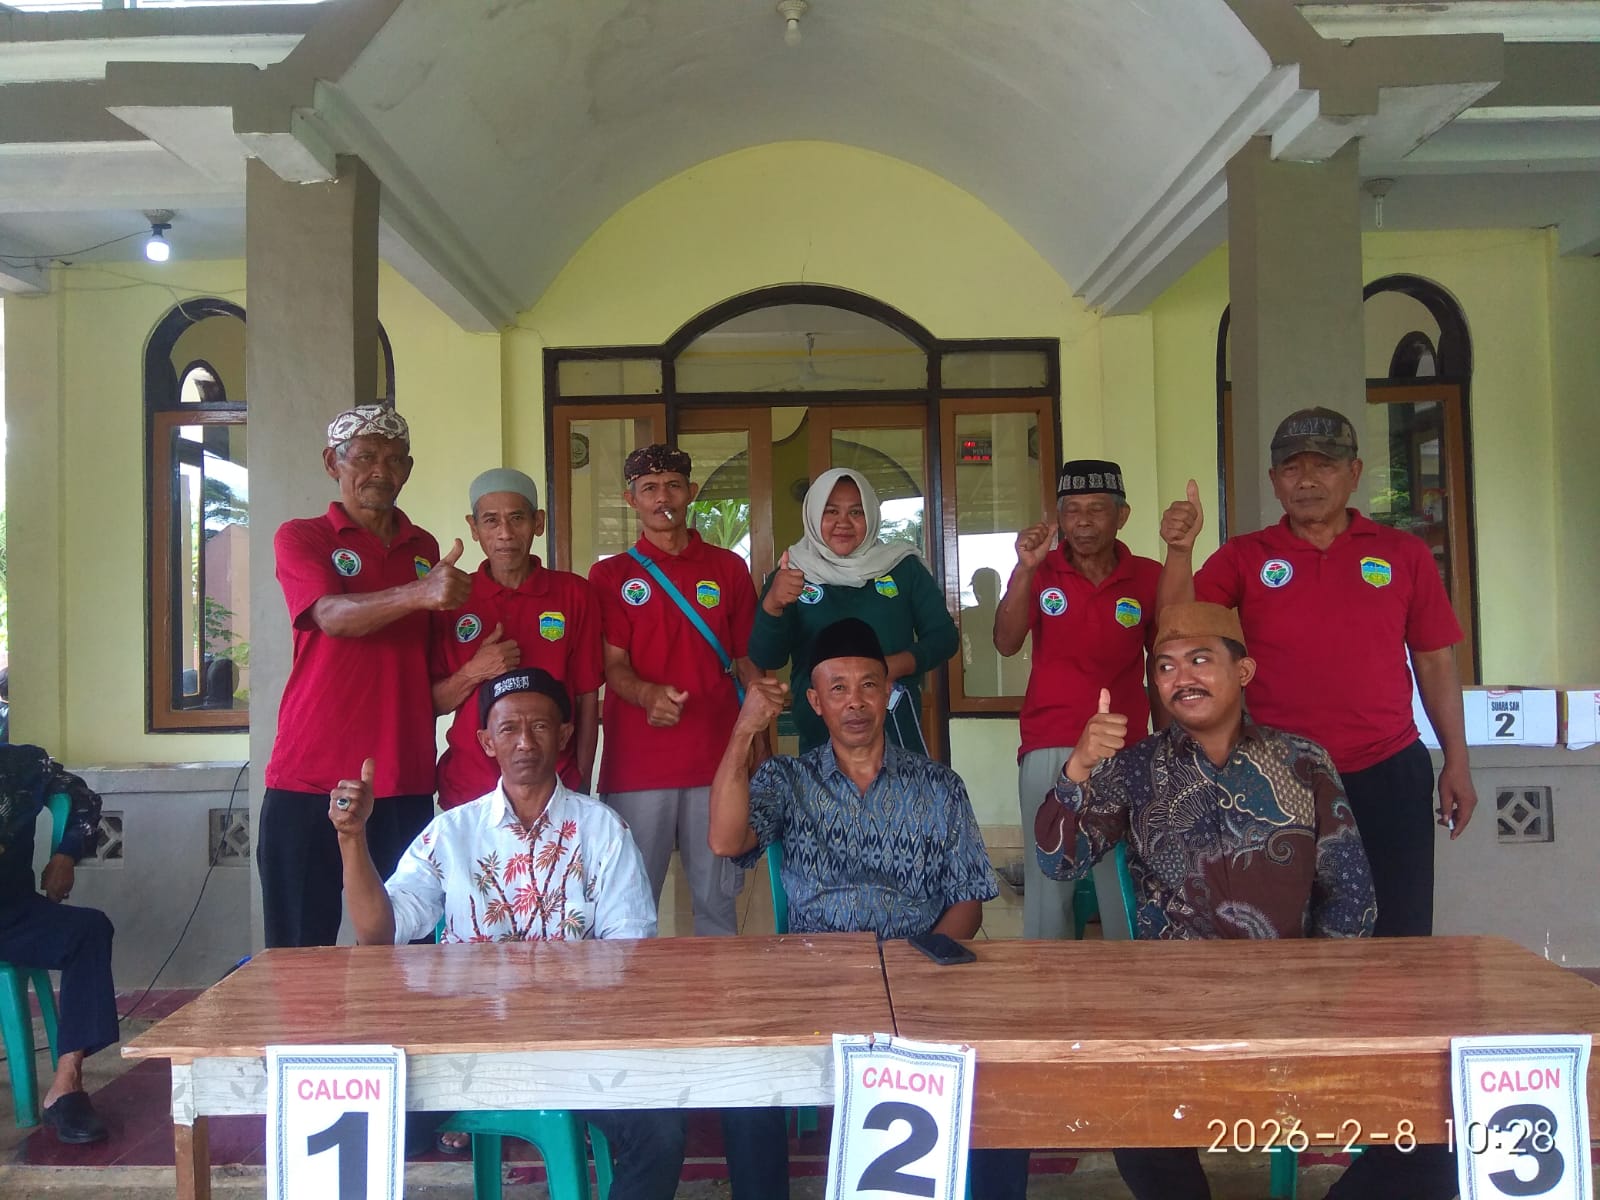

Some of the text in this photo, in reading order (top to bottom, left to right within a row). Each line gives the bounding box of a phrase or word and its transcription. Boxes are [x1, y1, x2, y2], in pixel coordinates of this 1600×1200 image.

[1491, 701, 1508, 711] SUARA
[1495, 712, 1515, 737] 2
[297, 1078, 381, 1101] CALON
[863, 1067, 944, 1096] CALON
[1480, 1068, 1561, 1093] CALON
[307, 1111, 369, 1200] 1
[856, 1101, 939, 1198] 2
[1486, 1103, 1565, 1197] 3
